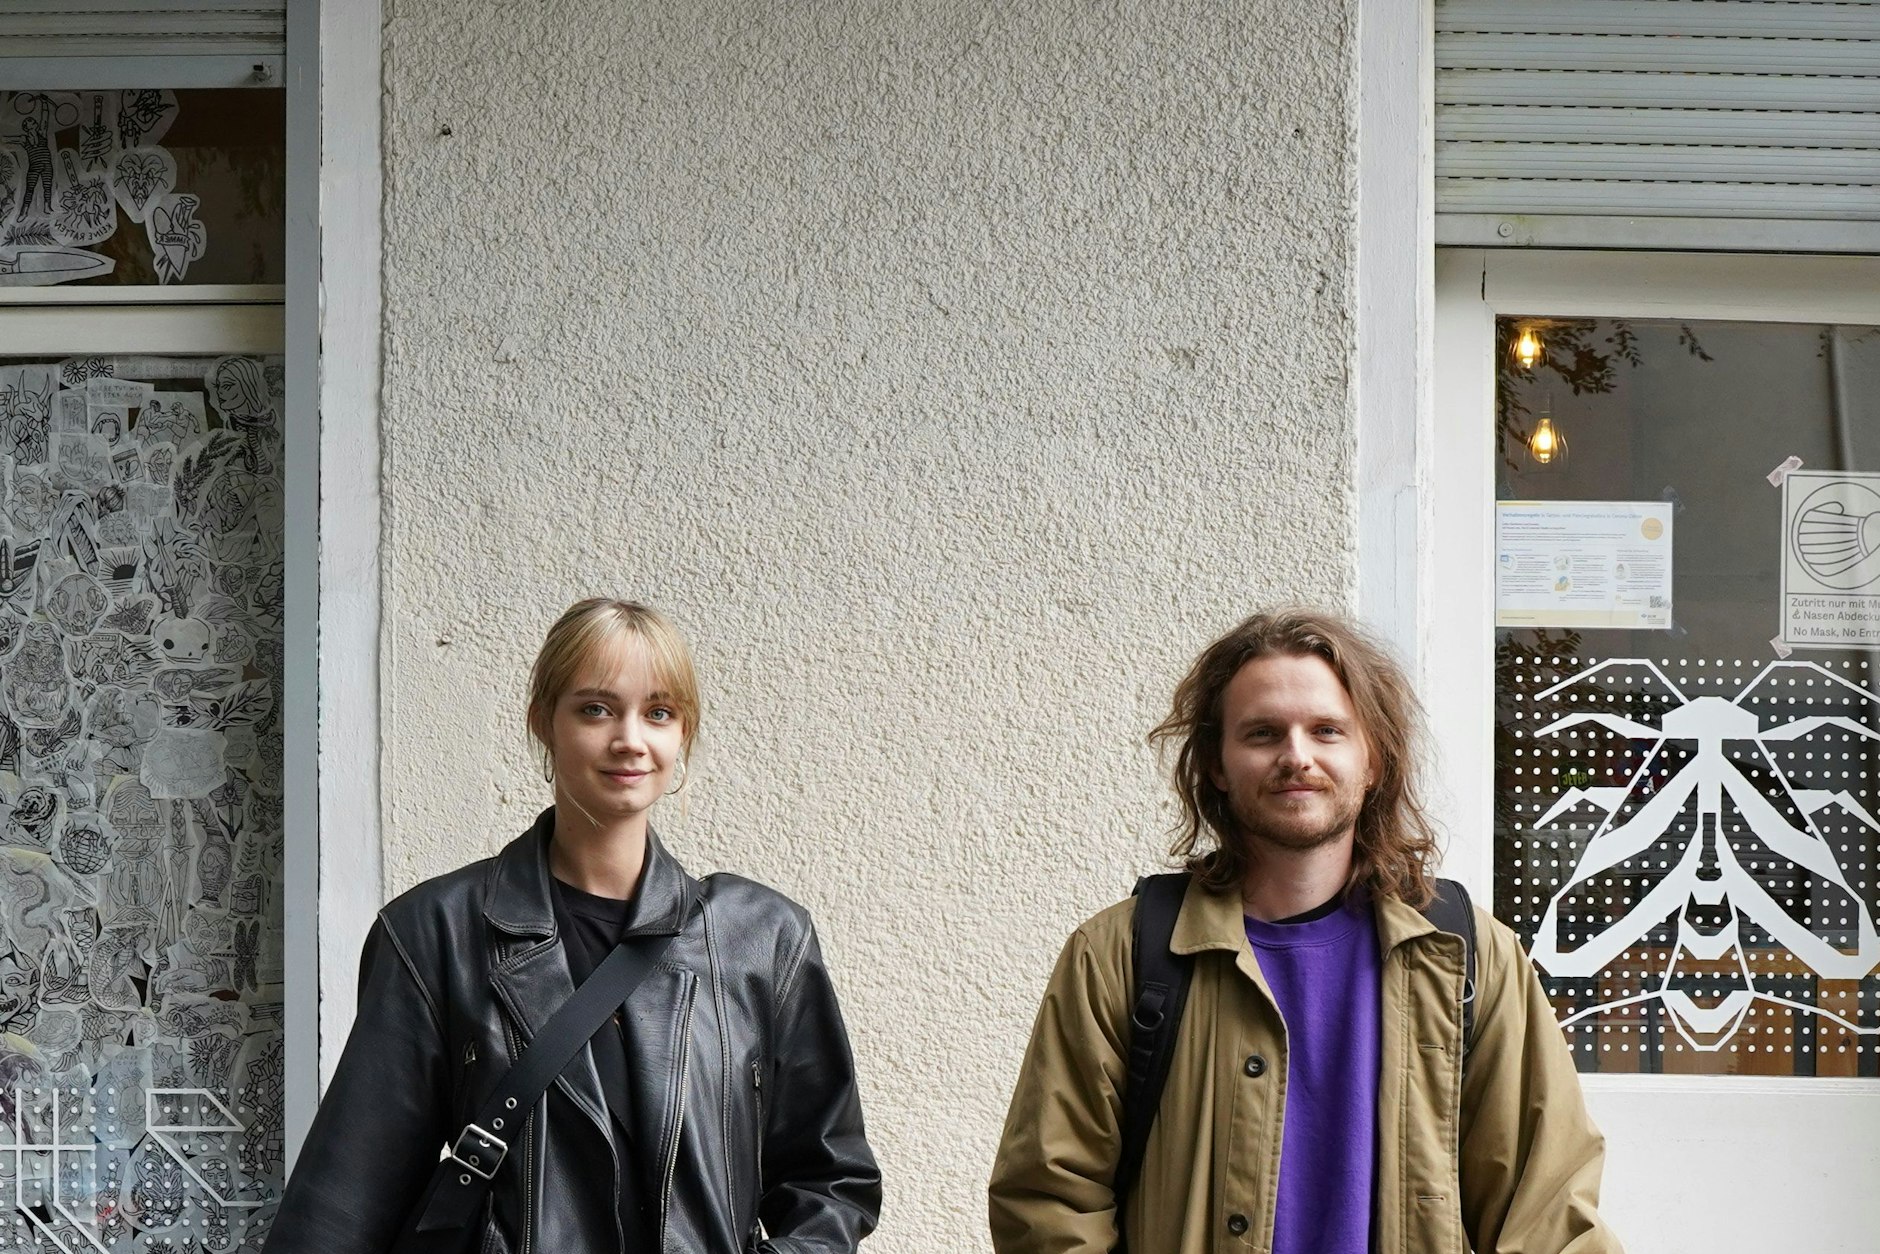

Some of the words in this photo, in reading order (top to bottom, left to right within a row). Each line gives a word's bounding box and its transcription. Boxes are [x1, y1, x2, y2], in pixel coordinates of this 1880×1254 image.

[1791, 597, 1826, 608] Zutritt
[1828, 600, 1847, 608] nur
[1849, 599, 1866, 609] mit
[1792, 608, 1801, 620] &
[1803, 611, 1835, 620] Nasen
[1793, 627, 1808, 636] No
[1810, 627, 1840, 638] Mask,
[1842, 628, 1857, 637] No
